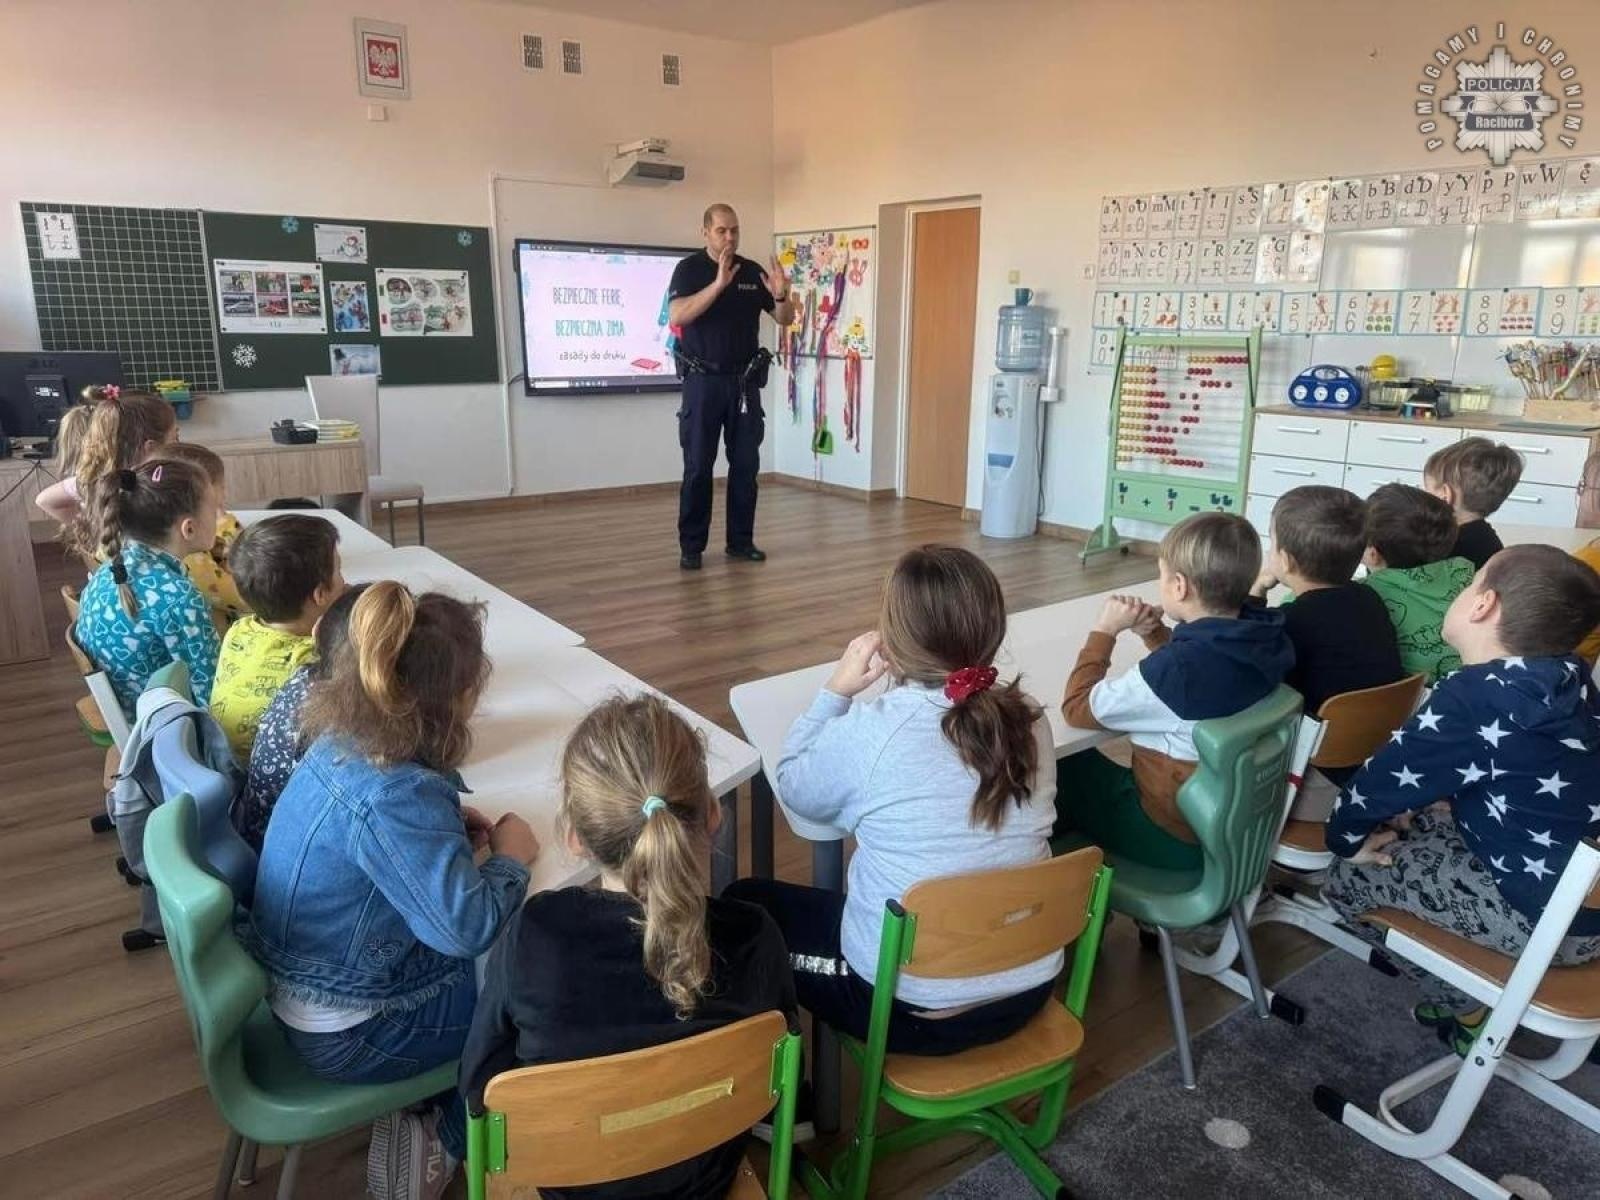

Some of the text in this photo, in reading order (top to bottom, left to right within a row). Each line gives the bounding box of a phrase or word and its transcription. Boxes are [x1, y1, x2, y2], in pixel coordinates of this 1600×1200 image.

[553, 287, 598, 305] BEZPIECZNE
[1143, 295, 1150, 308] 2
[1189, 296, 1197, 309] 3
[1239, 295, 1246, 308] 4
[1291, 298, 1300, 311] 5
[1348, 296, 1357, 309] 6
[1412, 295, 1422, 309] 7
[1480, 295, 1490, 309] 8
[1555, 294, 1565, 308] 9
[1141, 310, 1150, 328] 2
[1186, 310, 1196, 329] 3
[1236, 309, 1245, 326] 4
[1288, 312, 1299, 333] 5
[1345, 311, 1357, 333] 6
[1408, 311, 1421, 334] 7
[1476, 312, 1489, 335] 8
[1550, 311, 1564, 335] 9
[555, 319, 604, 337] BEZPIECZNA
[591, 349, 601, 360] do
[602, 349, 626, 361] druku
[426, 1138, 442, 1185] FILA
